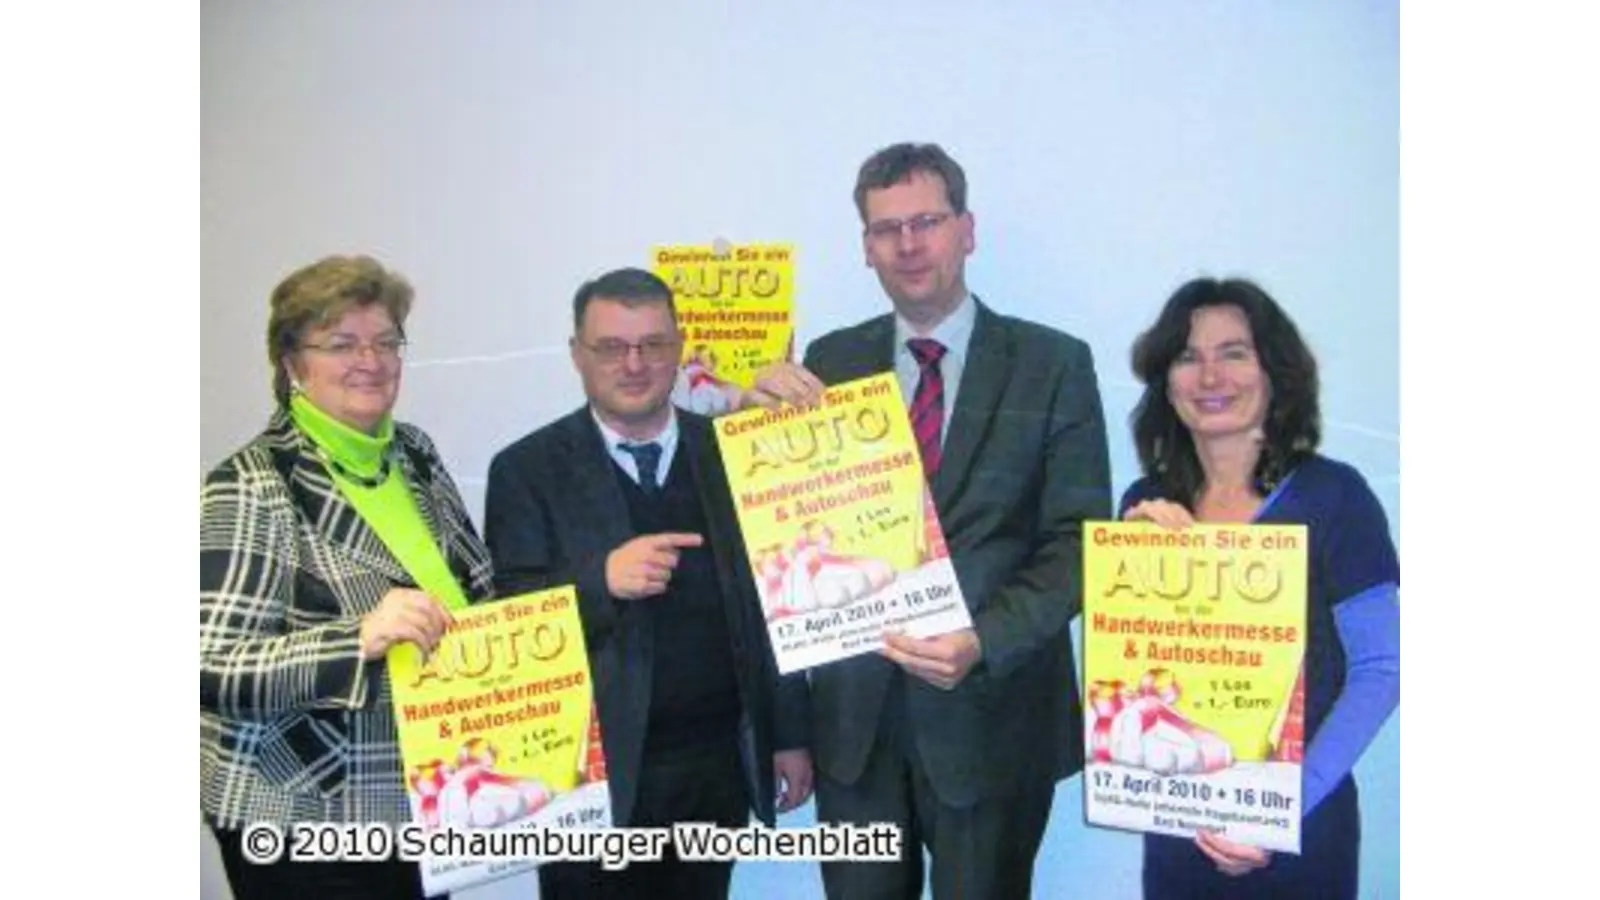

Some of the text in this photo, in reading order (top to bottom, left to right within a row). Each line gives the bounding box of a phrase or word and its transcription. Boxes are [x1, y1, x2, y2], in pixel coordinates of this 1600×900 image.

[671, 267, 780, 298] AUTO
[824, 388, 855, 407] Sie
[861, 380, 891, 398] ein
[746, 406, 892, 477] AUTO
[741, 451, 915, 508] Handwerkermesse
[774, 480, 893, 523] & Autoschau
[1093, 527, 1298, 550] Gewinnen Sie ein
[1103, 554, 1283, 604] AUTO
[504, 603, 534, 621] Sie
[541, 594, 570, 613] ein
[804, 611, 843, 633] April
[846, 600, 885, 622] 2010
[926, 583, 954, 603] Uhr
[1093, 612, 1297, 643] Handwerkermesse
[1123, 638, 1263, 667] & Autoschau
[403, 671, 585, 721] Handwerkermesse
[1234, 694, 1272, 710] Euro
[439, 700, 562, 739] & Autoschau
[1093, 771, 1119, 789] 17.
[1123, 774, 1163, 797] April
[1168, 778, 1212, 800] 2010
[1235, 788, 1256, 807] 16
[1261, 791, 1295, 810] Uhr
